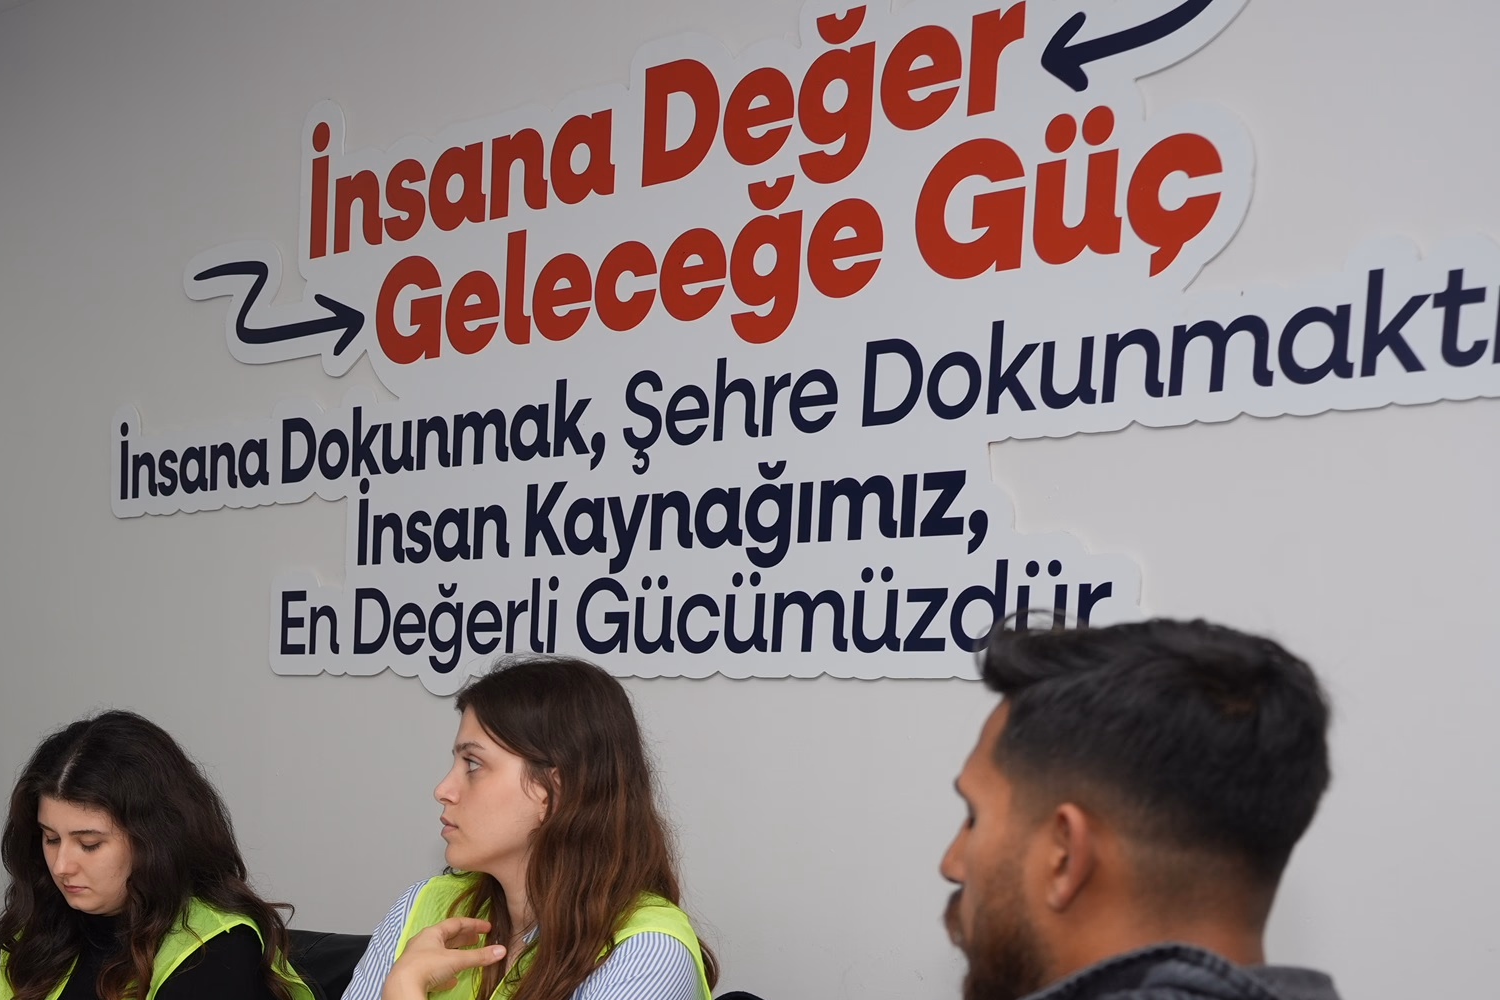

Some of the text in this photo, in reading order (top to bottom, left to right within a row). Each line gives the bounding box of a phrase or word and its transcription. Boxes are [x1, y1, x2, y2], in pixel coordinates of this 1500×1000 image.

[310, 0, 1026, 259] İnsana Değer
[376, 105, 1223, 365] Geleceğe Güç
[119, 421, 270, 501] İnsana
[280, 378, 606, 486] Dokunmak,
[622, 357, 840, 476] Şehre
[357, 460, 989, 575] İnsan Kaynağımız,
[280, 590, 340, 655] En
[353, 576, 558, 674] Değerli
